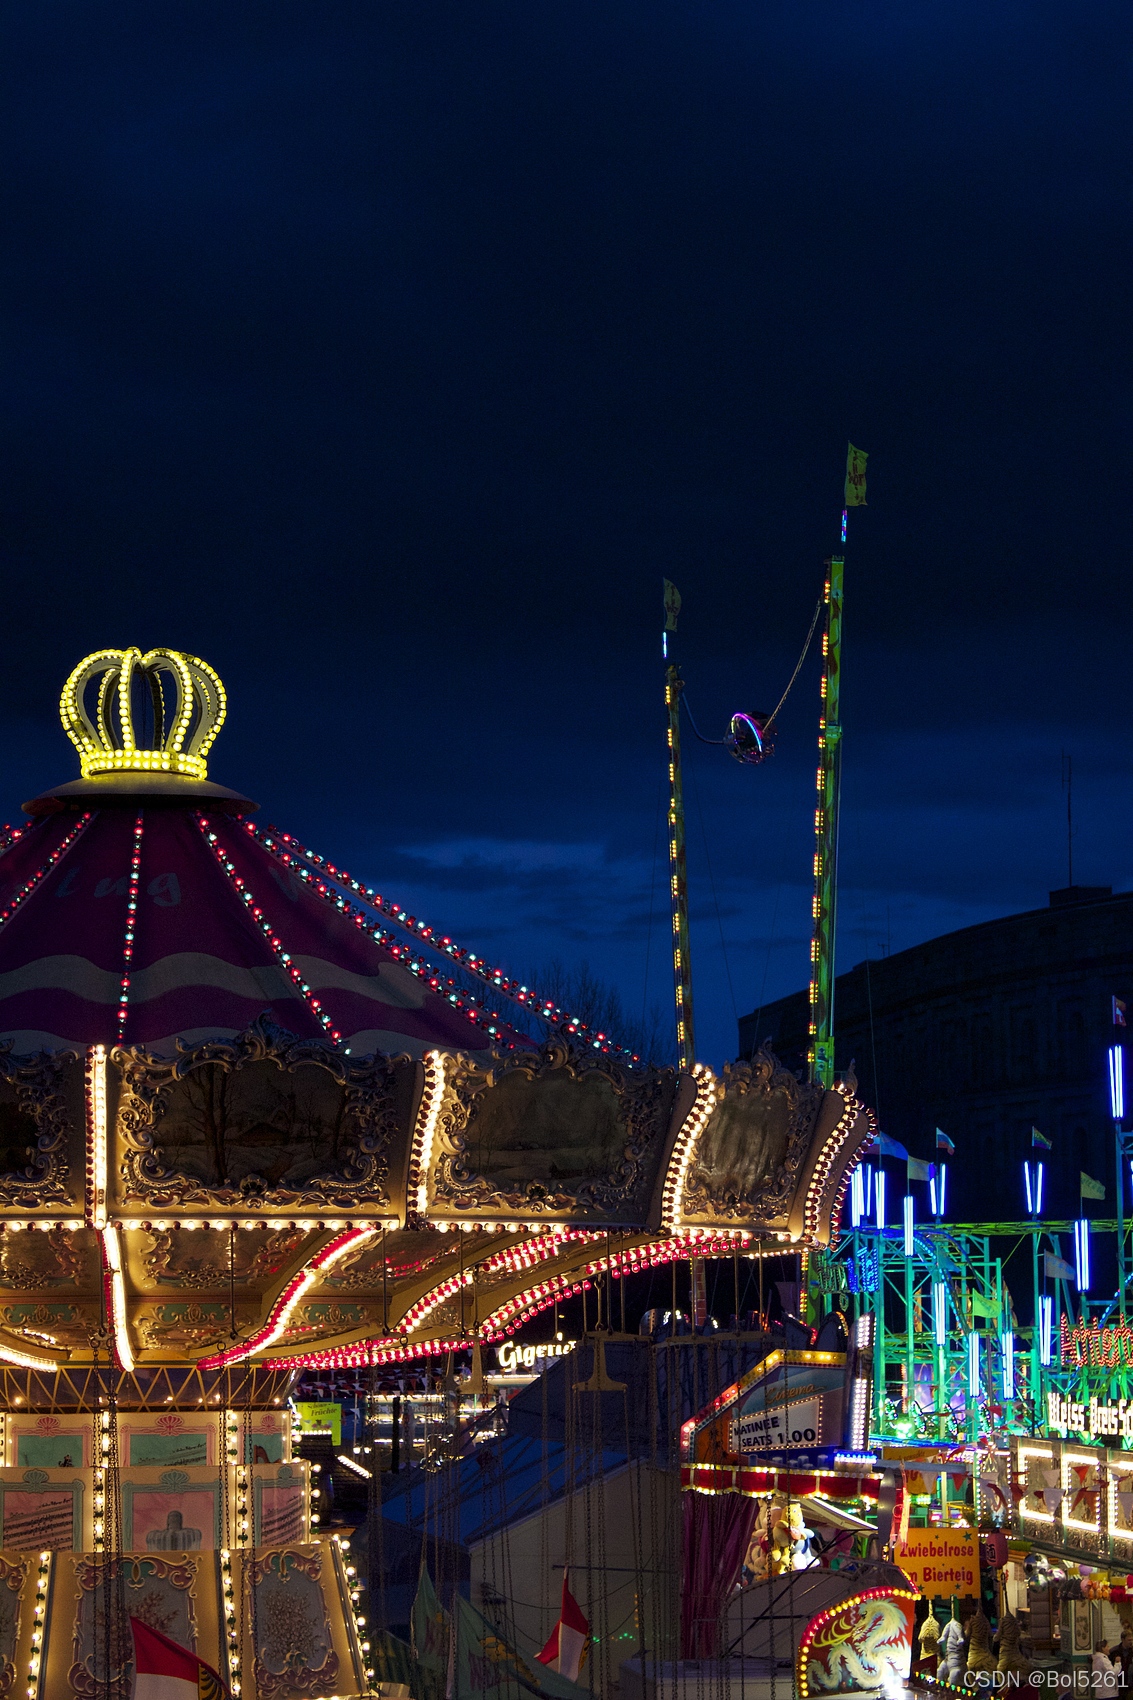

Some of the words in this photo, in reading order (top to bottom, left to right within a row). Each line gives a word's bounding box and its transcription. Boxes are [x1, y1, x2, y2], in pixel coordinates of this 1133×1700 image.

[310, 1407, 338, 1417] Früchte
[734, 1416, 780, 1436] MATINEE
[742, 1435, 773, 1447] SEATS
[899, 1541, 974, 1557] Zwiebelrose
[923, 1566, 973, 1586] Bierteig
